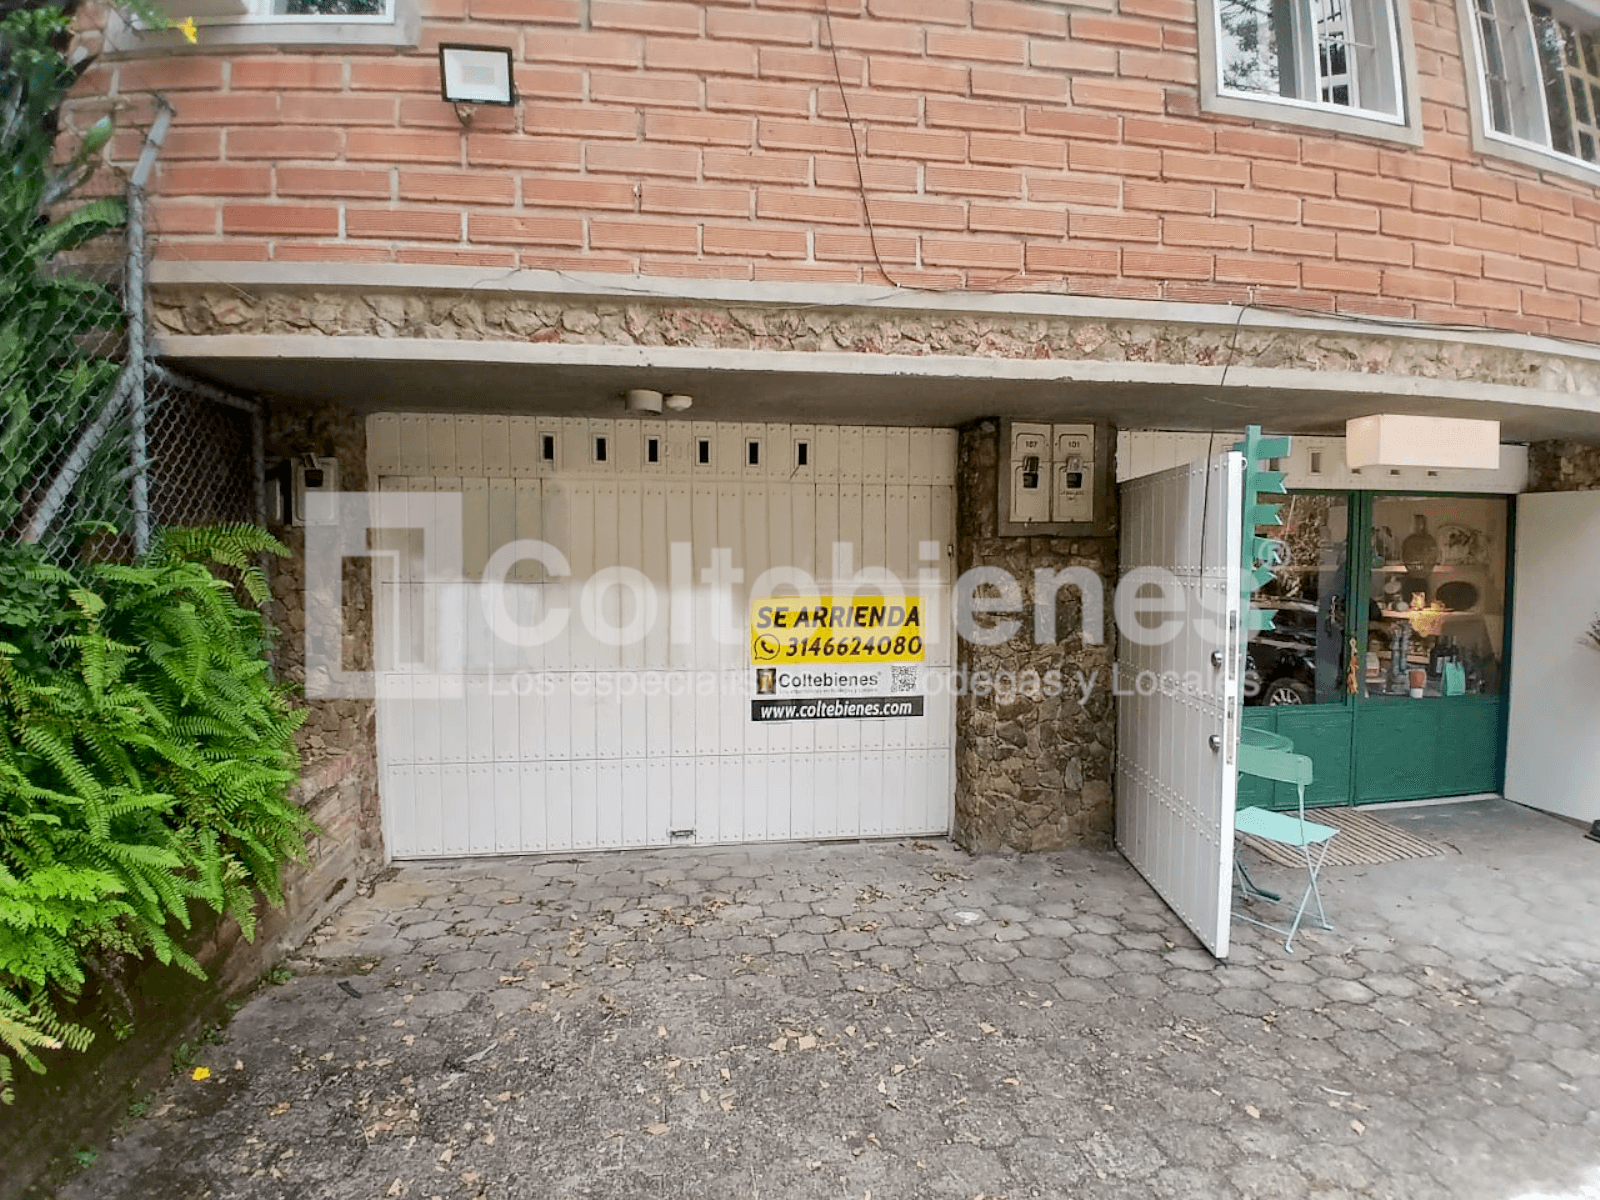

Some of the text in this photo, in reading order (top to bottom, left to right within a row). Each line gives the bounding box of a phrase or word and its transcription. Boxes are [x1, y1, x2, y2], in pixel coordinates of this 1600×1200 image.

[756, 605, 920, 629] SE ARRIENDA
[785, 636, 922, 657] 3146624080
[778, 672, 879, 688] Coltebienes
[760, 700, 912, 720] www.coltebienes.com
